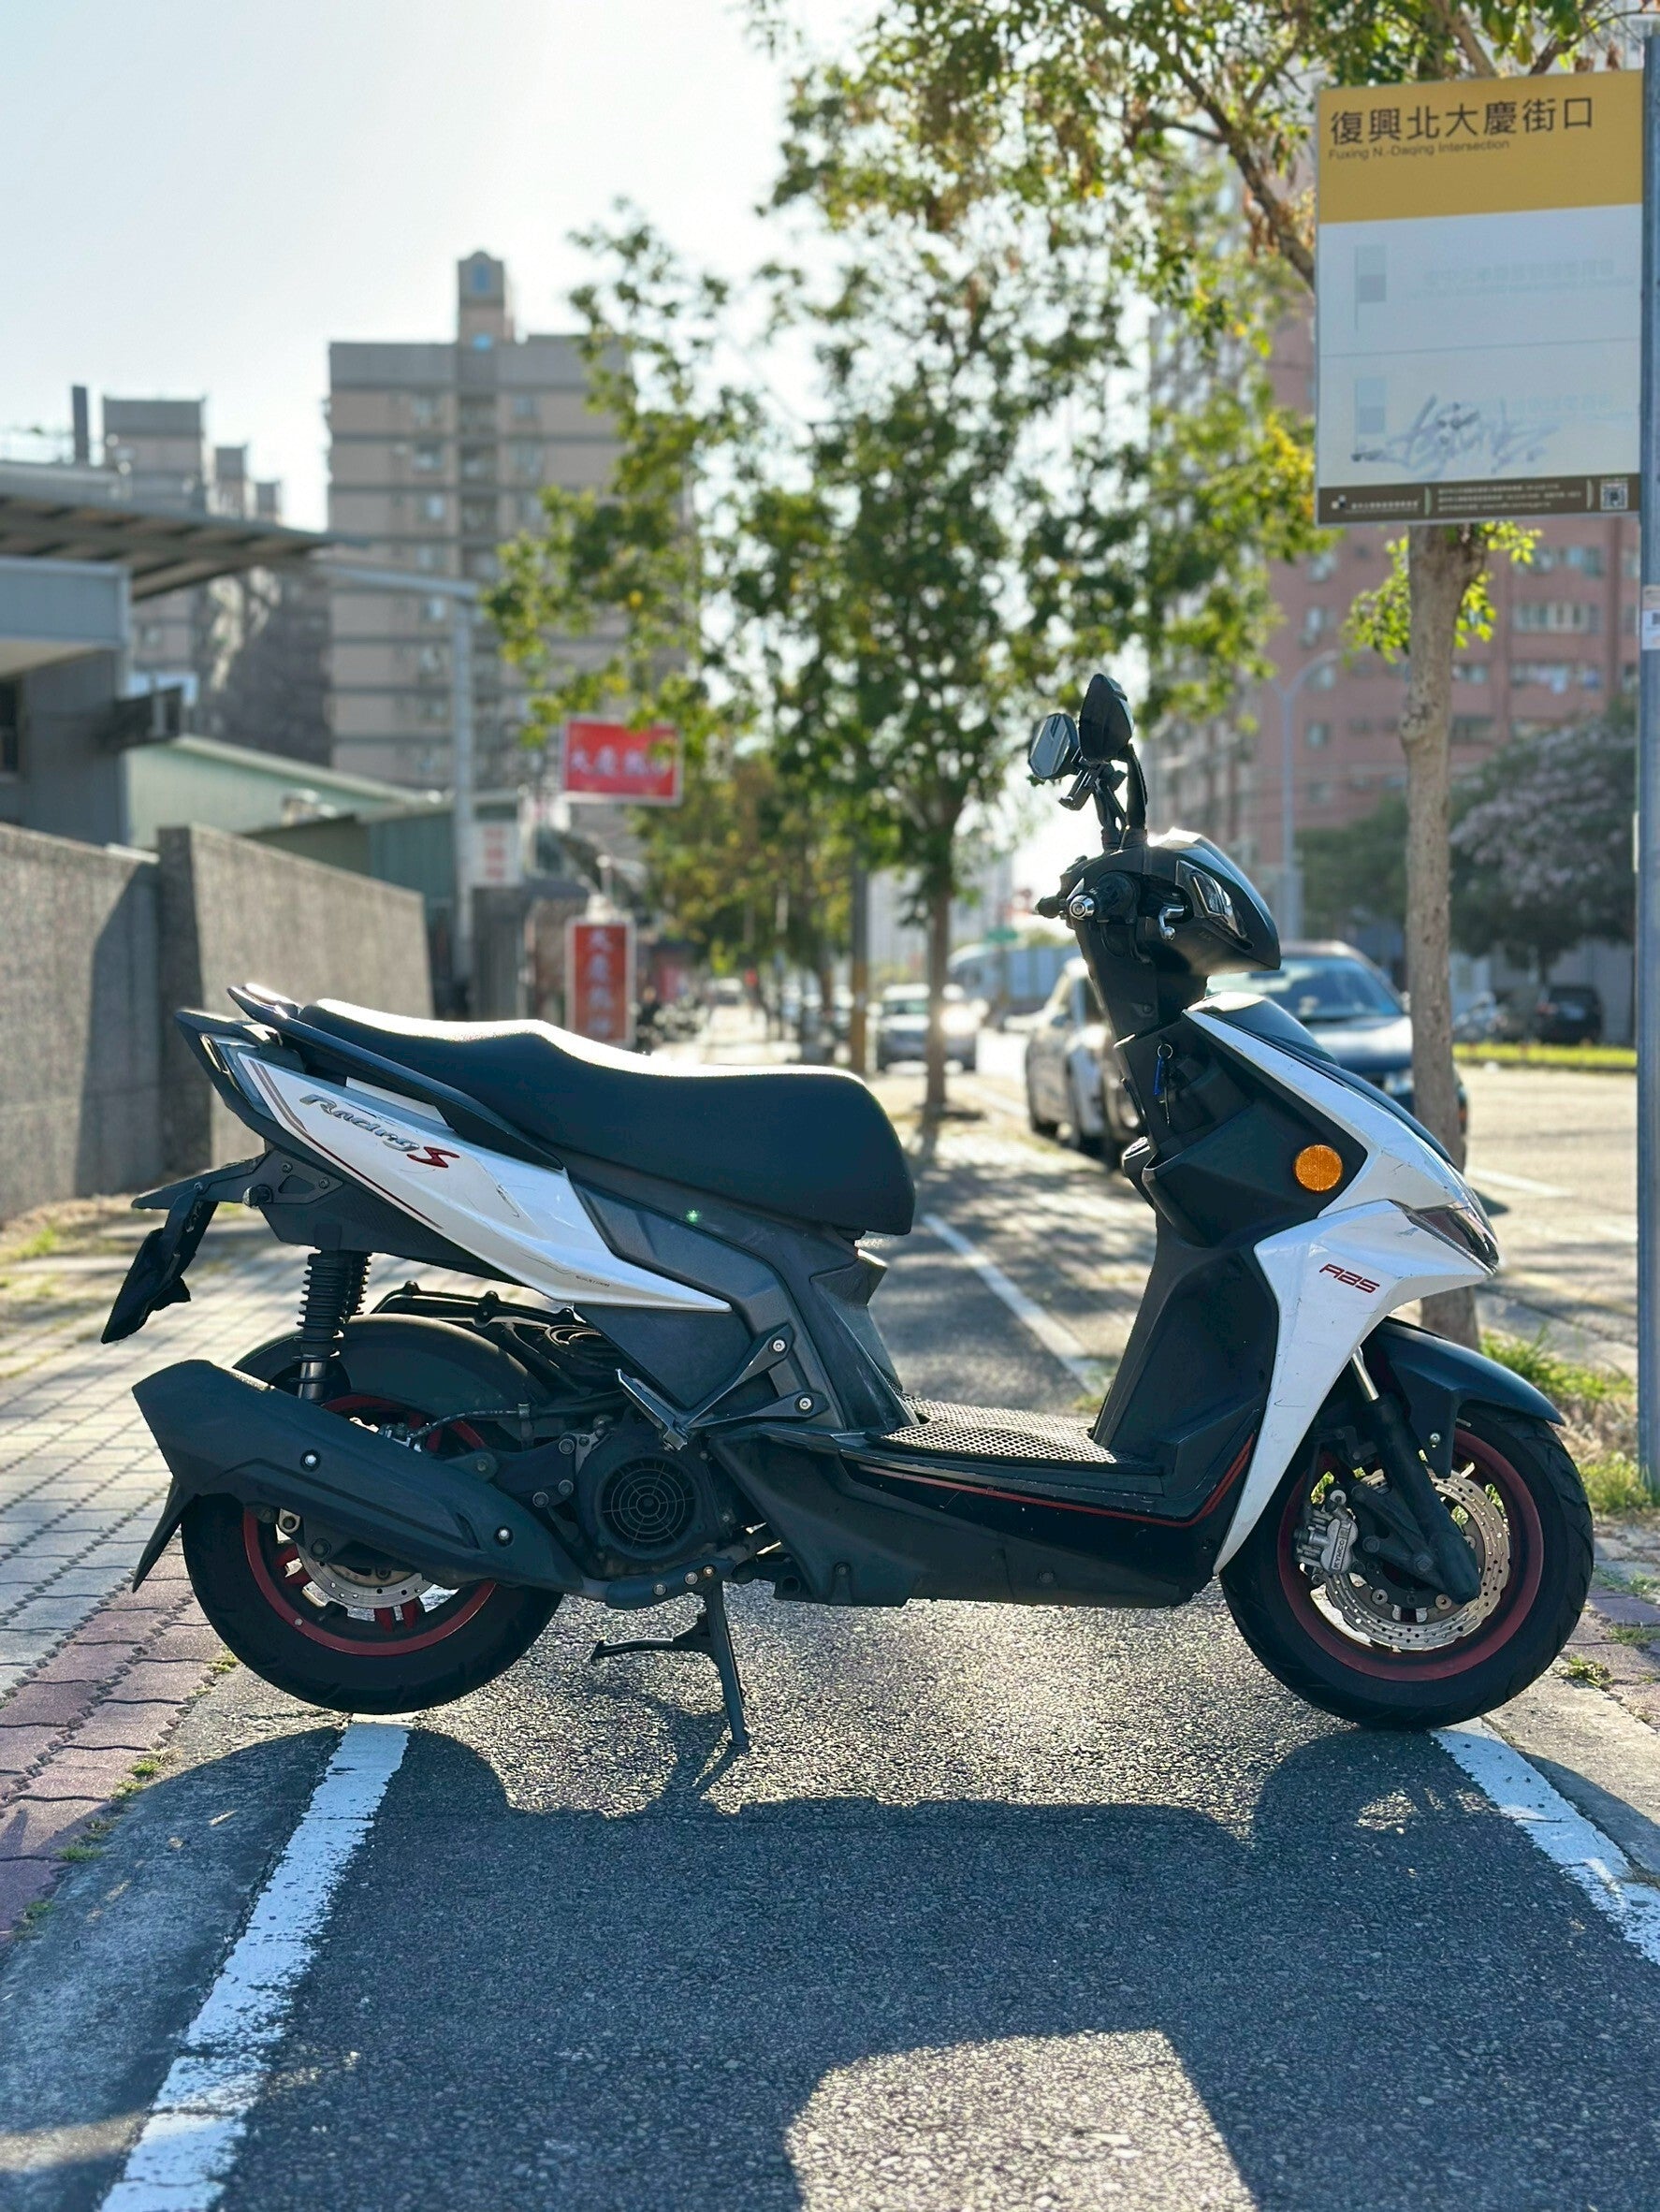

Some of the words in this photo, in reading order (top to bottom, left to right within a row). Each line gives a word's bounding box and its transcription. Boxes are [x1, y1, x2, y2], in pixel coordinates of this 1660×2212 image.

[1330, 97, 1593, 146] 復興北大慶街口
[1329, 149, 1369, 162] Fuxing
[1438, 138, 1510, 153] Intersection
[299, 1093, 420, 1152] Racing
[406, 1145, 460, 1169] S
[1318, 1263, 1380, 1293] ABS
[1332, 1539, 1346, 1569] KYMCO
